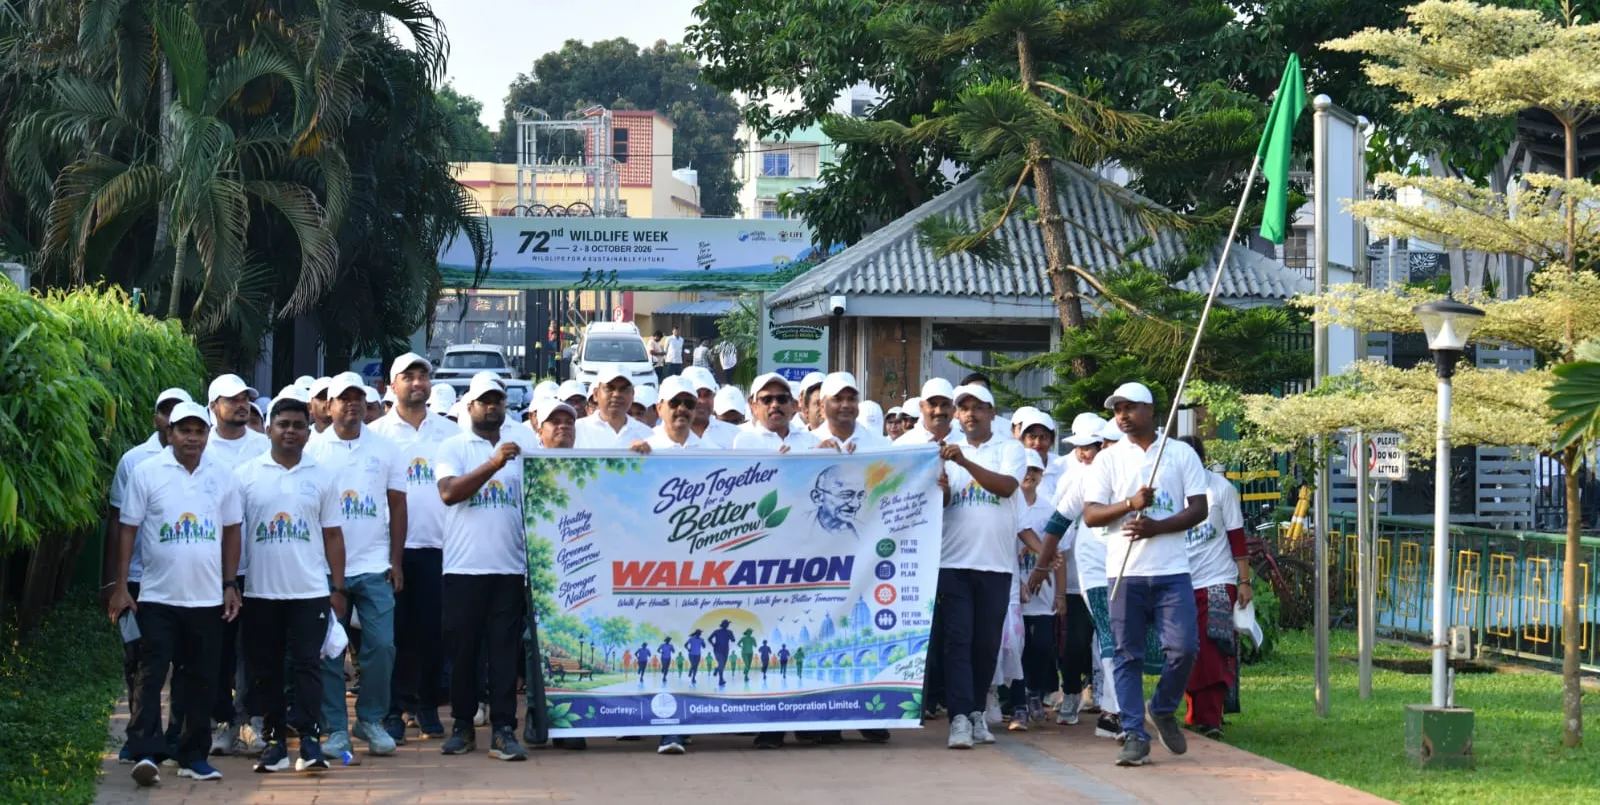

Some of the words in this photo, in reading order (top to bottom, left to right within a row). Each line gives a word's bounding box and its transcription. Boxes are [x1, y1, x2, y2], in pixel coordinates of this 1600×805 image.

[517, 227, 564, 254] 72nd
[569, 230, 629, 242] WILDLIFE
[633, 231, 669, 243] WEEK
[572, 245, 578, 253] 2
[591, 245, 632, 253] OCTOBER
[1377, 451, 1387, 460] DO
[1378, 465, 1399, 473] LITTER
[653, 477, 706, 514] Step
[705, 462, 779, 496] Together
[704, 496, 718, 510] for
[558, 509, 592, 531] Healthy
[667, 500, 757, 543] Better
[560, 523, 591, 542] People
[687, 520, 761, 554] Tomorrow
[557, 542, 593, 563] Greener
[561, 550, 600, 573] Tomorrow
[612, 555, 855, 587] WALKATHON
[900, 570, 916, 578] PLAN
[558, 574, 597, 599] Stronger
[564, 587, 596, 608] Nation
[617, 598, 637, 608] Walk
[636, 598, 648, 609] for
[649, 598, 671, 607] Health
[681, 598, 699, 607] Walk
[700, 598, 711, 609] for
[712, 598, 743, 609] Harmony
[754, 595, 771, 605] Walk
[770, 595, 782, 607] for
[790, 593, 813, 605] Better
[814, 593, 848, 603] Tomorrow
[600, 706, 638, 715] Courtesy:-
[689, 703, 719, 713] Odisha
[721, 702, 777, 712] Construction
[778, 701, 827, 712] Corporation
[828, 700, 860, 710] Limited.
